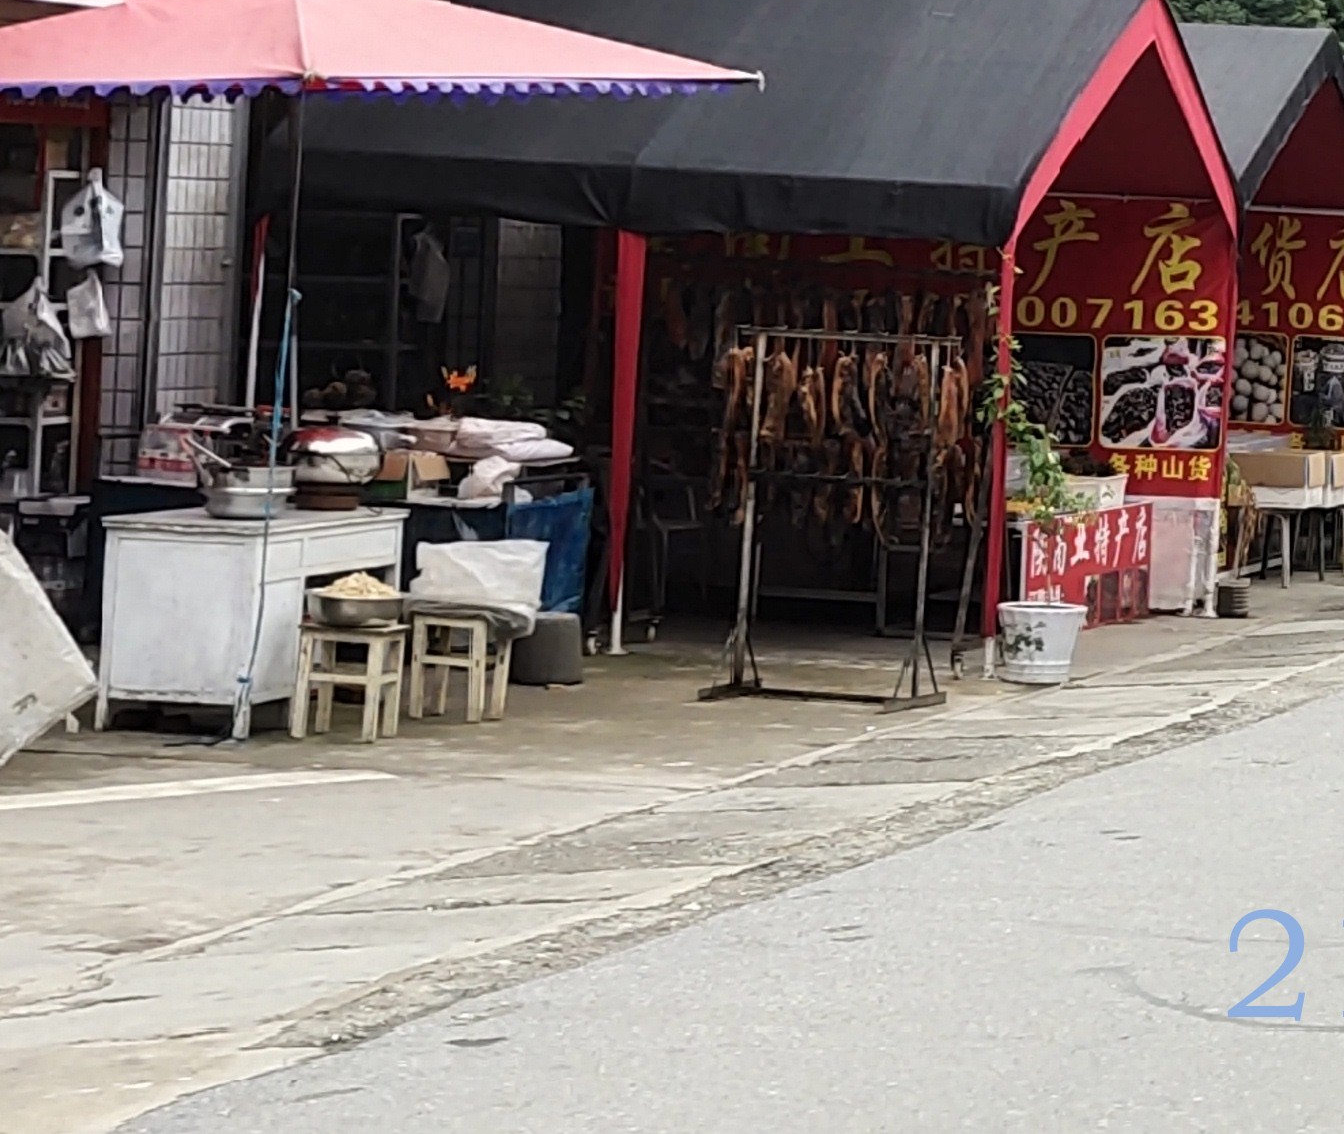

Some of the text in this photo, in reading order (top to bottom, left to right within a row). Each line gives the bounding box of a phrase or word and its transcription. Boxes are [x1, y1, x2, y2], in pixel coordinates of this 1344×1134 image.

[1026, 199, 1204, 295] 产店
[1017, 297, 1219, 331] 007163
[1109, 453, 1213, 481] 各种山货
